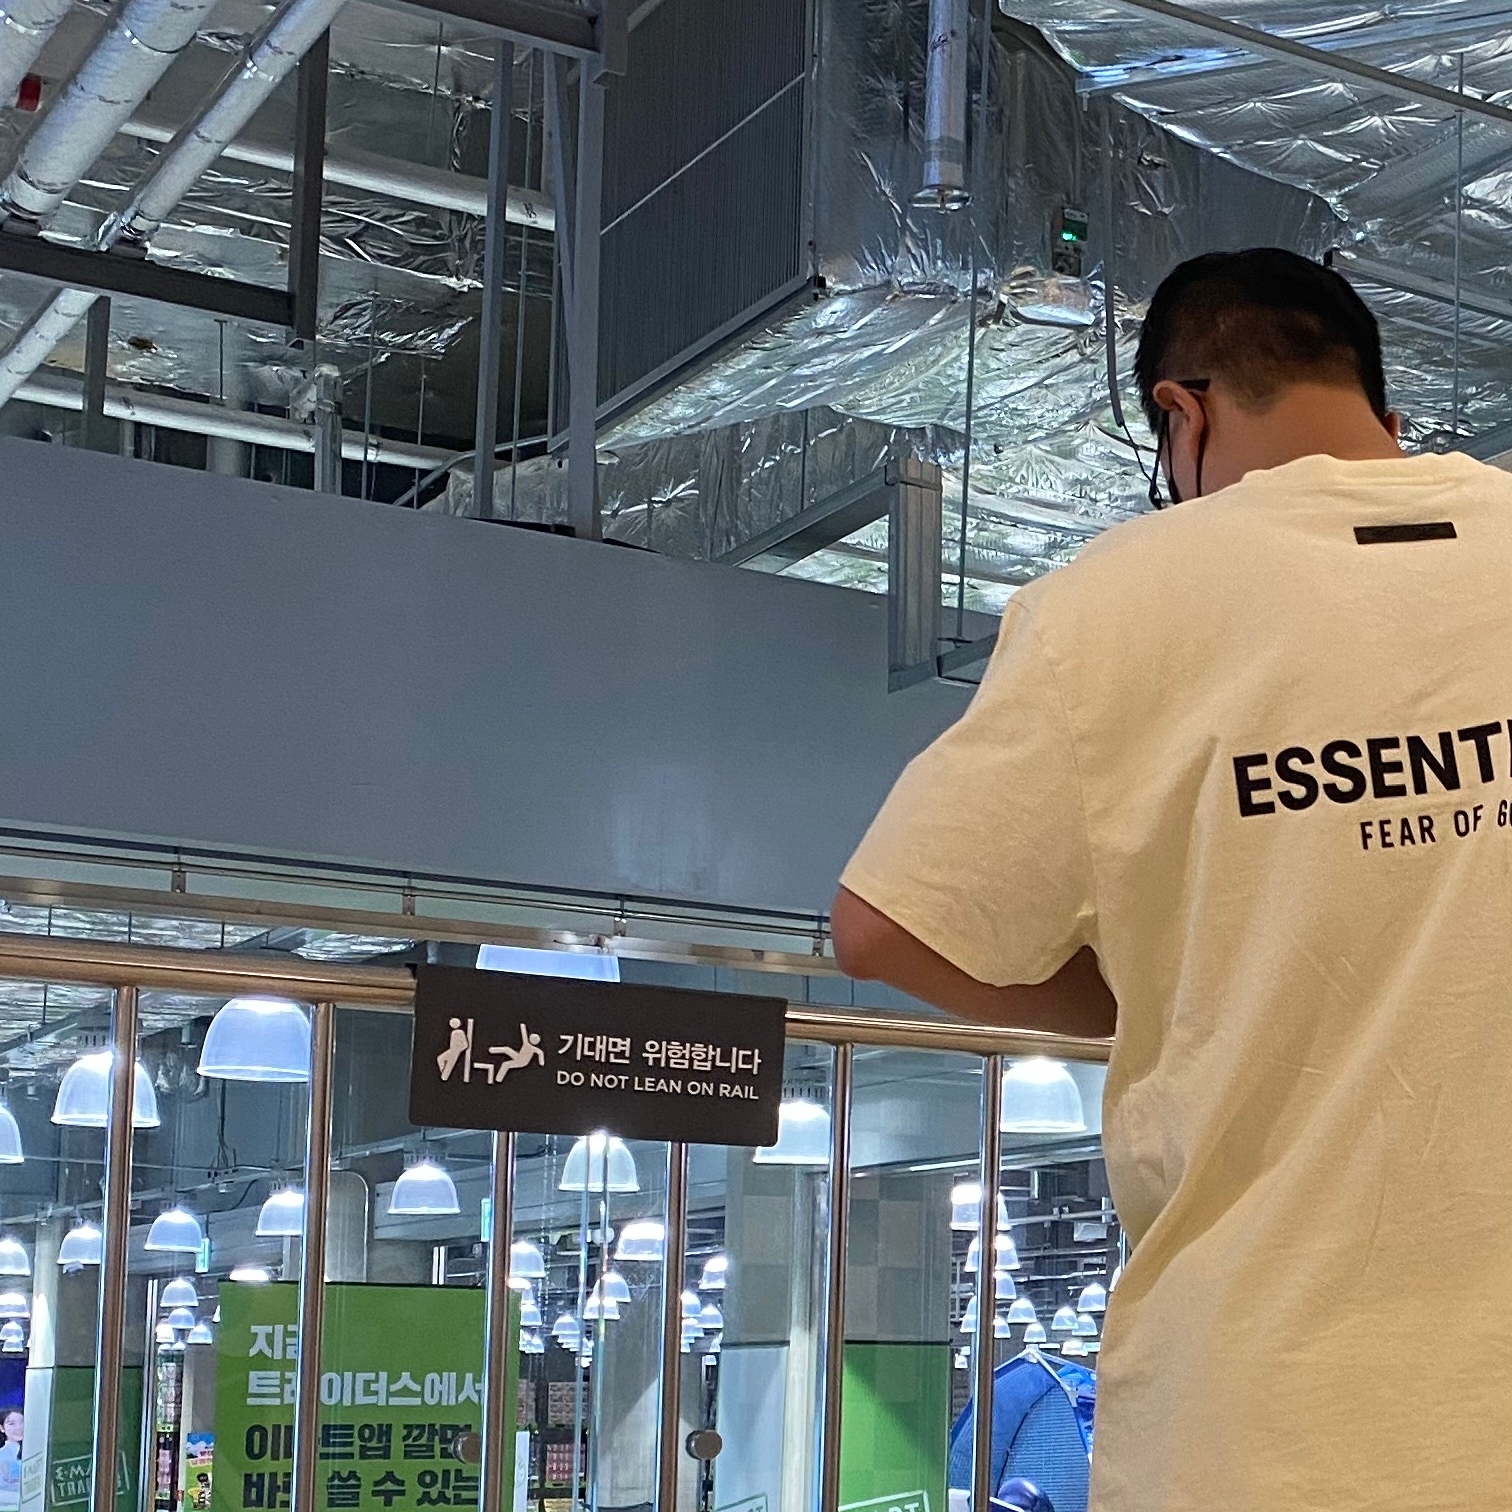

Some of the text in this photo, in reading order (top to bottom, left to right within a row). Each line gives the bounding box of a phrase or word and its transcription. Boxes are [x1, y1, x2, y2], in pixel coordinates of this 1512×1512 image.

[1360, 815, 1436, 851] FEAR
[1454, 804, 1484, 837] OF
[558, 1033, 762, 1075] 기대면 위험합니다
[556, 1070, 759, 1100] DO NOT LEAN ON RAIL
[245, 1422, 393, 1462] 이트앱
[243, 1471, 292, 1509] 바
[326, 1471, 362, 1508] 쓸
[371, 1470, 406, 1508] 수
